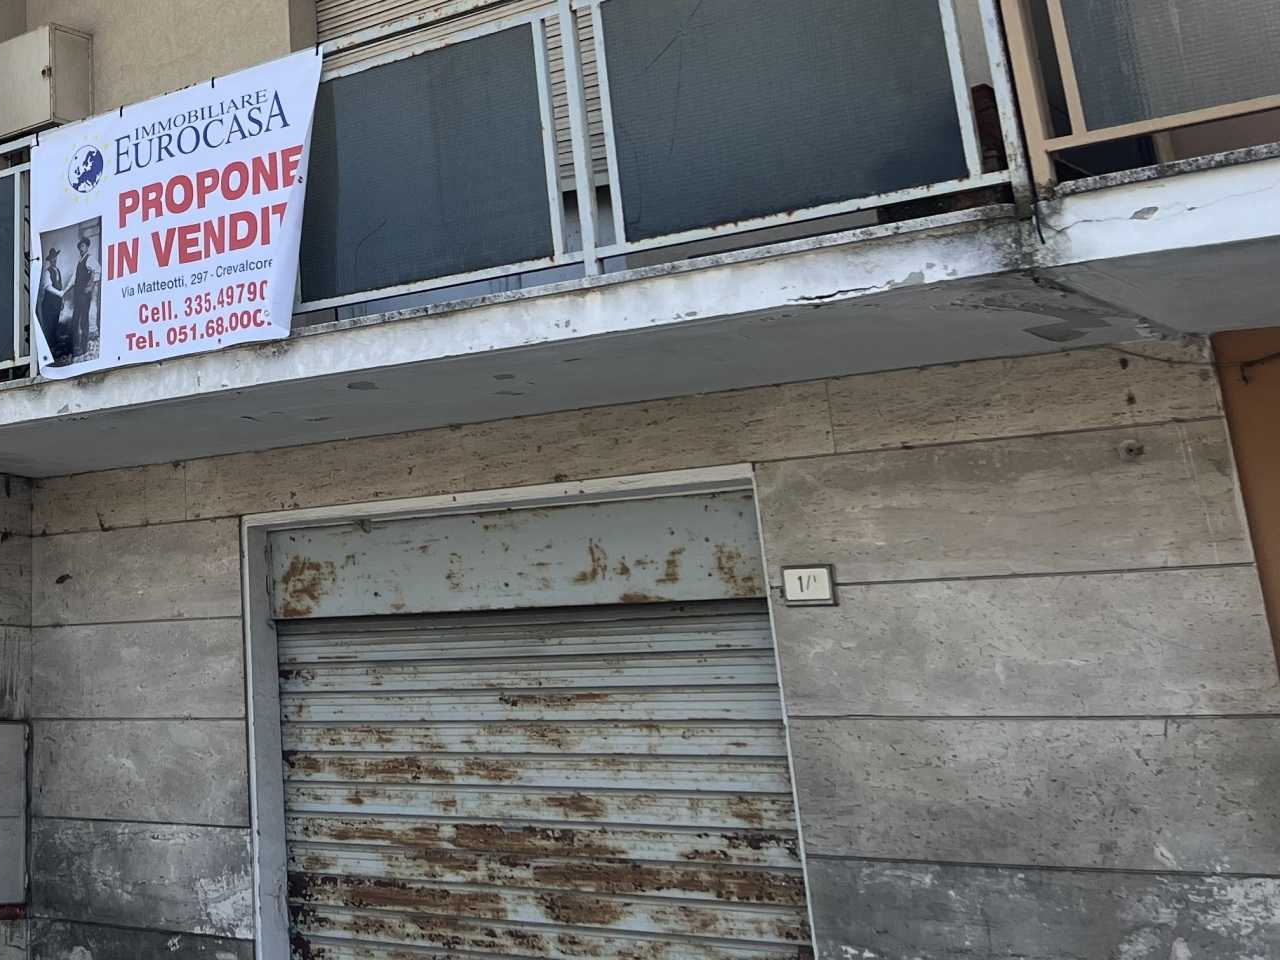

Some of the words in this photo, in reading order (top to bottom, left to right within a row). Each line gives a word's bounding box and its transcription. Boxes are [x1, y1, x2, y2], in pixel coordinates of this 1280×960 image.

[114, 90, 290, 175] EUROCASA
[135, 89, 268, 141] IMMOBILIARE
[119, 144, 304, 228] PROPONE
[107, 238, 139, 281] IN
[122, 286, 135, 298] Via
[137, 275, 188, 295] Matteotti,
[191, 271, 208, 286] 297
[139, 300, 178, 324] Cell.
[126, 330, 160, 351] Tel.
